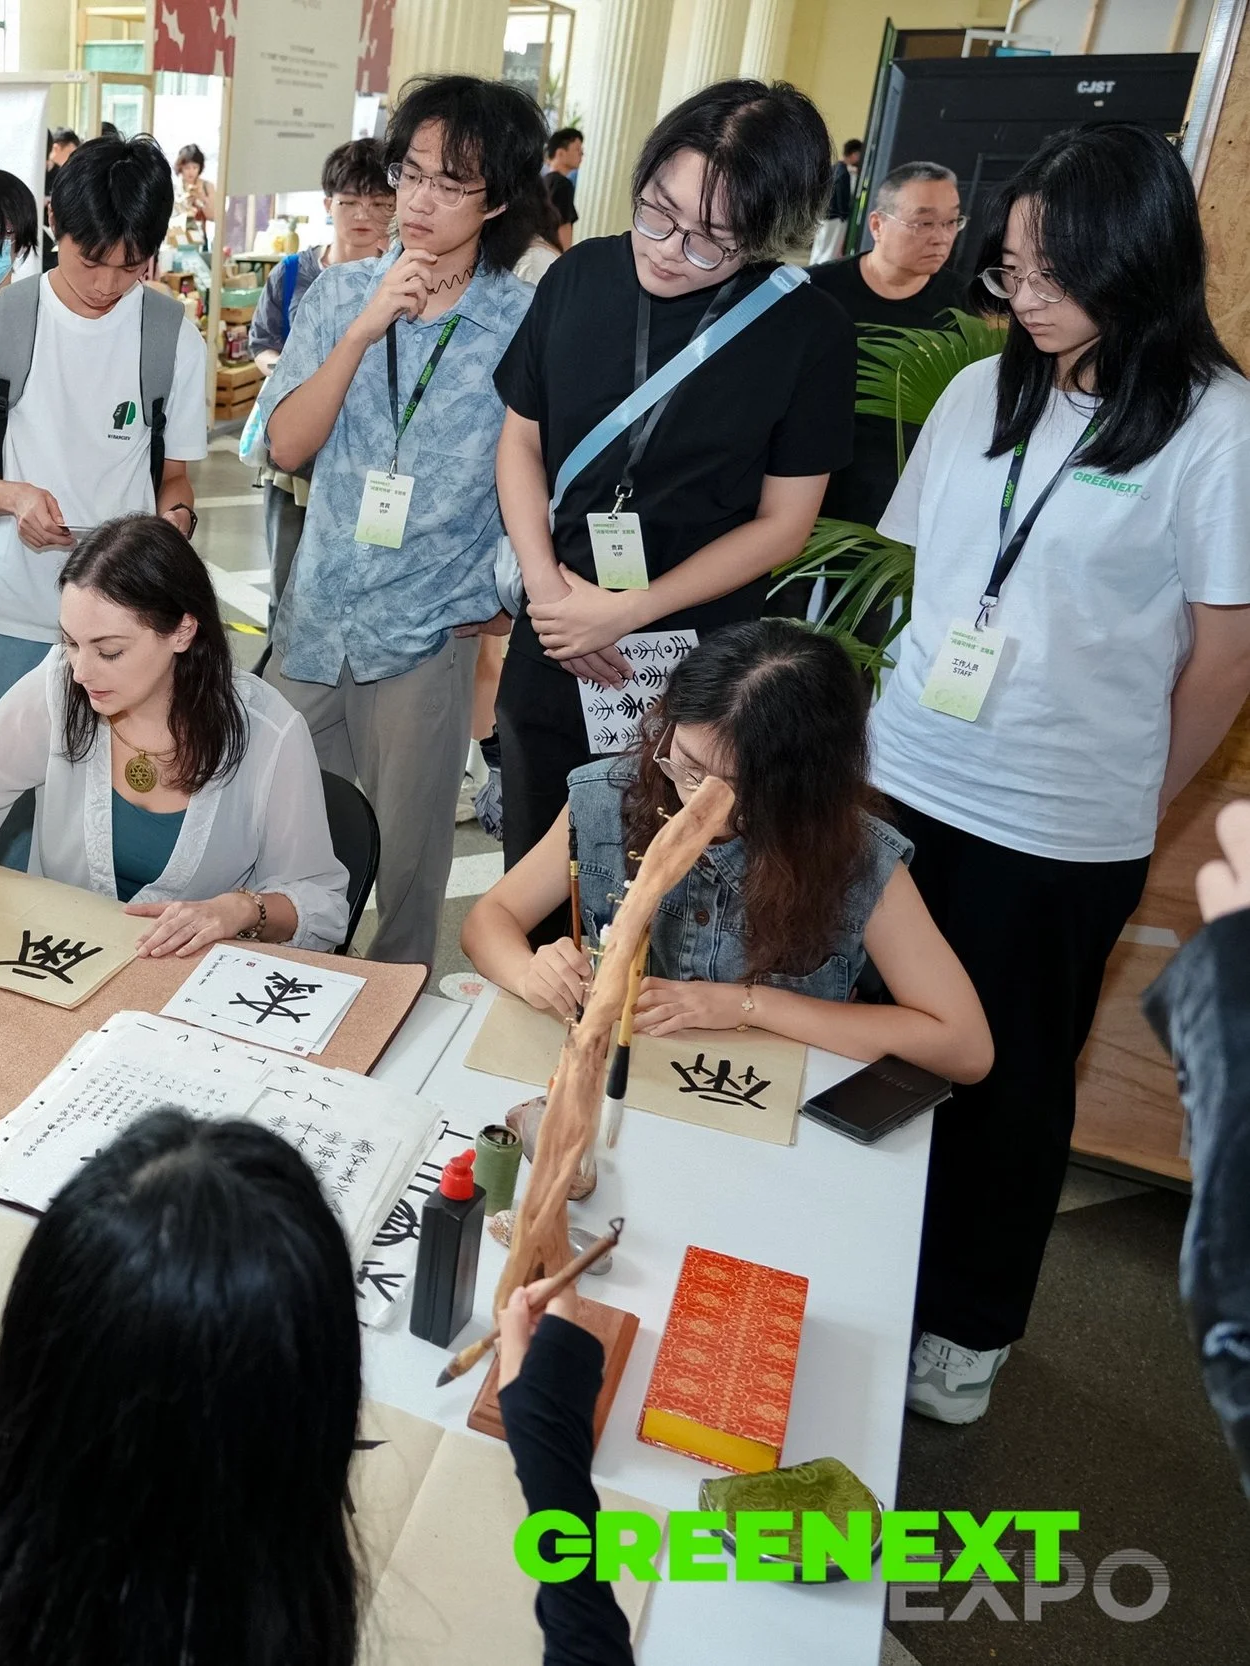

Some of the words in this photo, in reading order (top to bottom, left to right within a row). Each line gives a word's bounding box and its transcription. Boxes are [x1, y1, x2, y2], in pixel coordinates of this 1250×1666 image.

[1077, 80, 1116, 93] CJST
[1073, 471, 1143, 494] GREENEXT
[951, 658, 979, 671] 工作人员
[953, 667, 973, 677] STAFF
